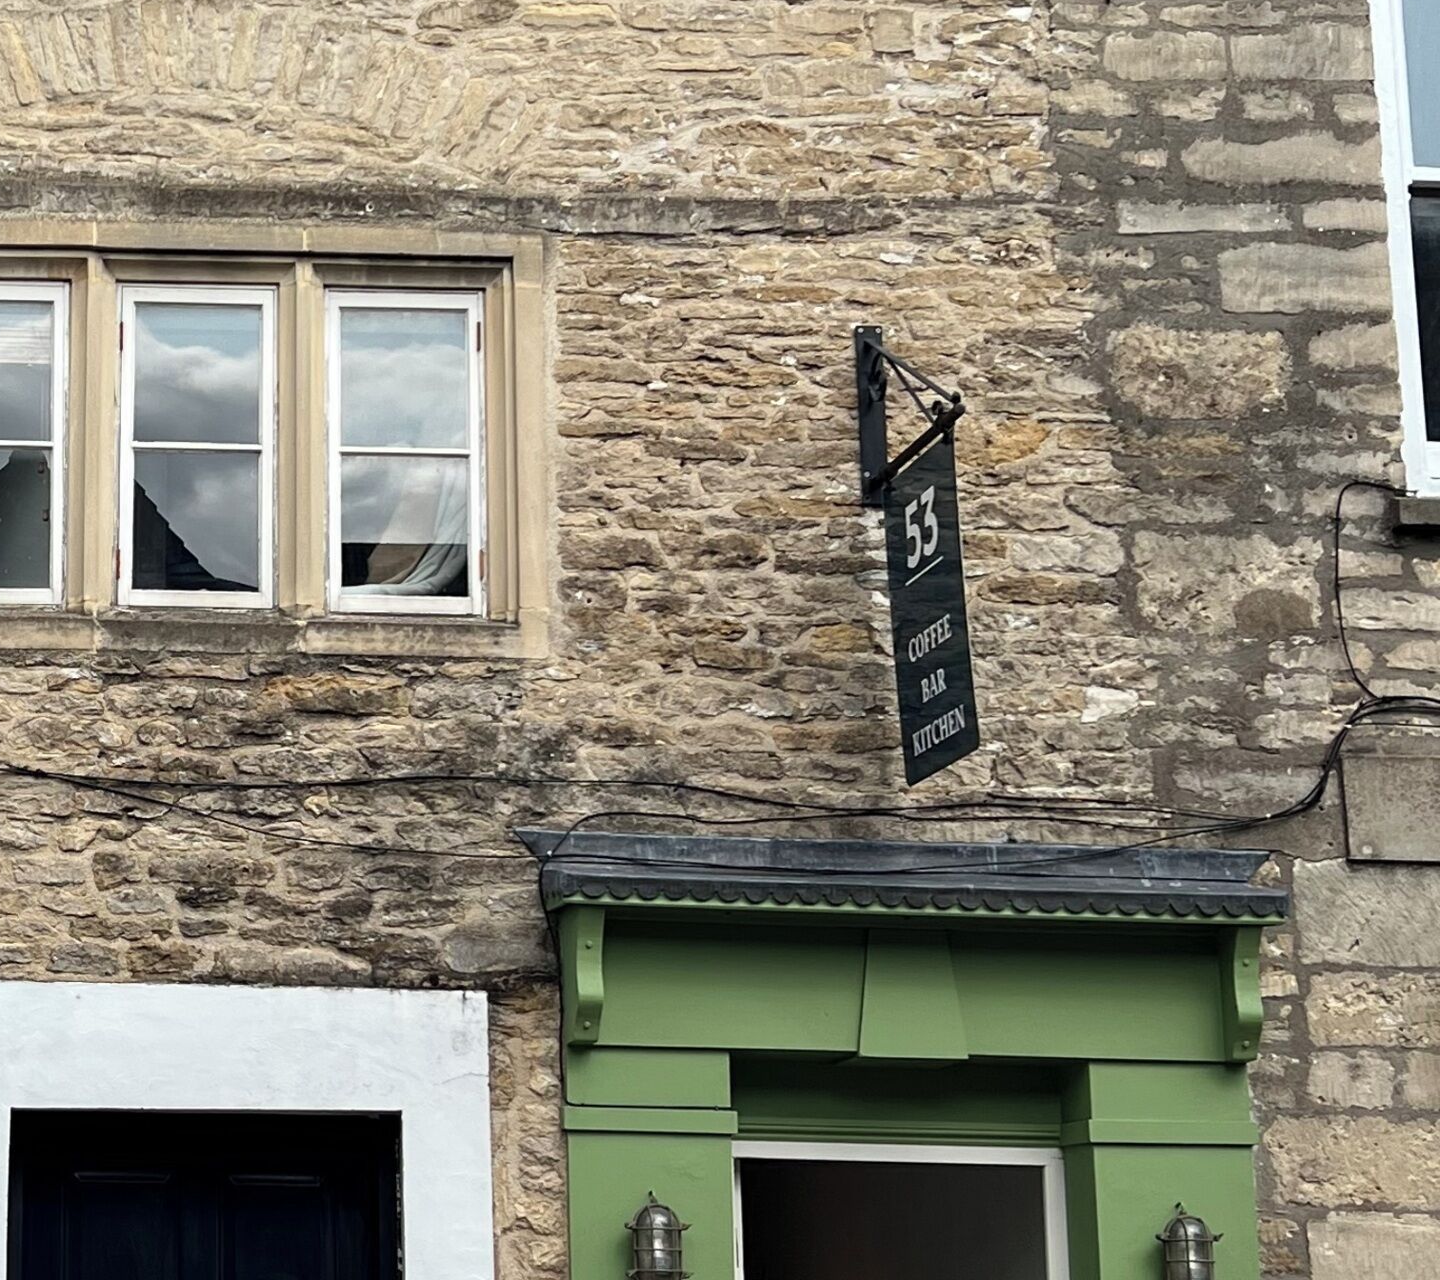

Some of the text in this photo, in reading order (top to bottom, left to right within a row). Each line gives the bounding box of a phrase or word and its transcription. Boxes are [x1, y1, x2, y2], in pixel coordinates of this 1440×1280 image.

[905, 485, 939, 569] 53
[908, 613, 952, 663] COFFEE
[921, 668, 947, 703] BAR
[913, 704, 965, 757] KITCHEN
